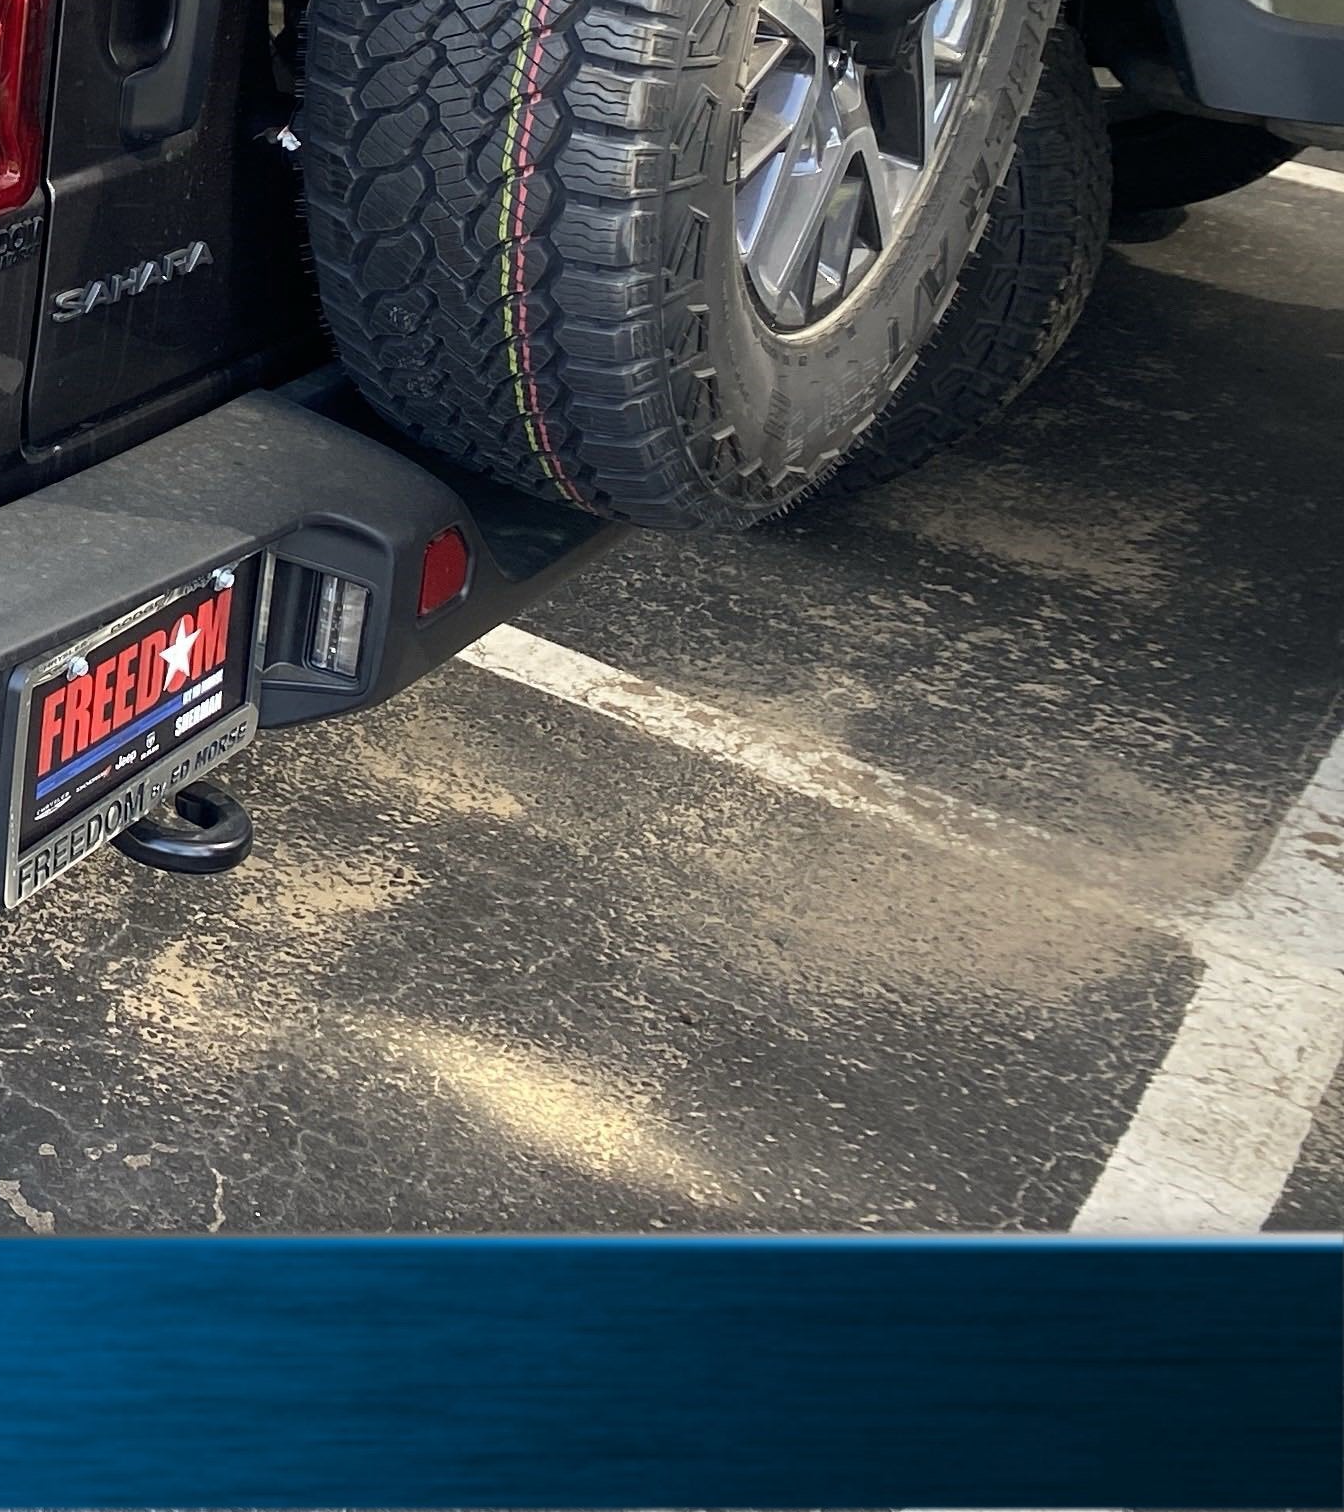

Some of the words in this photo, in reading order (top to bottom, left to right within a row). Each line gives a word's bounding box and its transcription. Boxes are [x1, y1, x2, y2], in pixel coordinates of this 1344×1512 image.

[51, 239, 214, 323] SAHARA
[37, 587, 233, 777] FREEDOM
[19, 781, 146, 900] FREEDOM
[170, 758, 190, 785] ED
[194, 720, 249, 772] MORSE
[114, 749, 138, 771] Jeep
